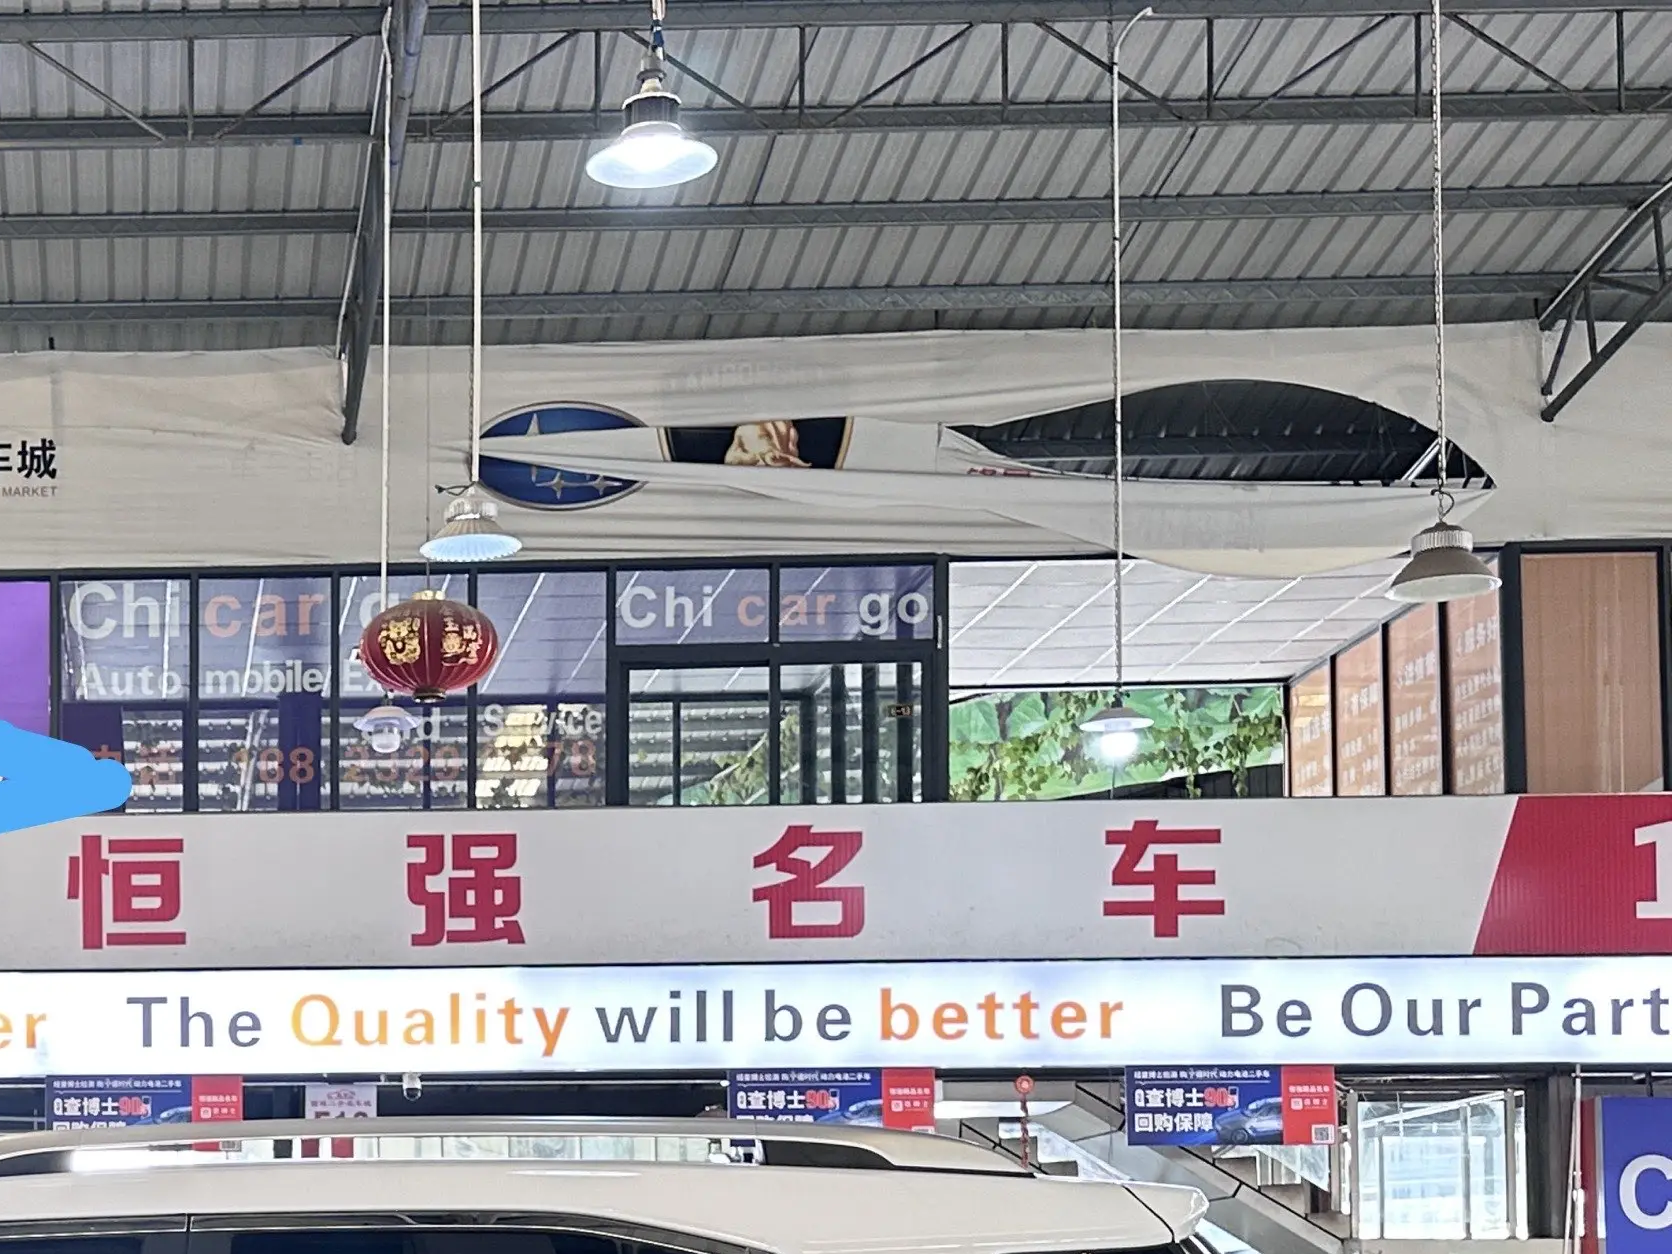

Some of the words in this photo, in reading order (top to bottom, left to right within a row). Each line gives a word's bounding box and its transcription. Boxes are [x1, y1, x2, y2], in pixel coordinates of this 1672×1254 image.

[2, 486, 57, 498] MARKET
[70, 583, 180, 639] Chi
[205, 593, 324, 638] car
[618, 584, 714, 629] Chi
[737, 593, 836, 628] car
[860, 593, 928, 635] go
[80, 662, 181, 696] Auto
[206, 660, 323, 693] mobile
[67, 819, 1226, 950] 恒强名车
[126, 996, 262, 1048] The
[291, 993, 571, 1058] Quality
[595, 990, 734, 1043] will
[764, 988, 853, 1042] be
[880, 987, 1124, 1042] better
[1220, 984, 1313, 1038] Be
[1341, 982, 1482, 1038] Our
[1511, 982, 1671, 1036] Part
[1134, 1112, 1214, 1132] 回购保障
